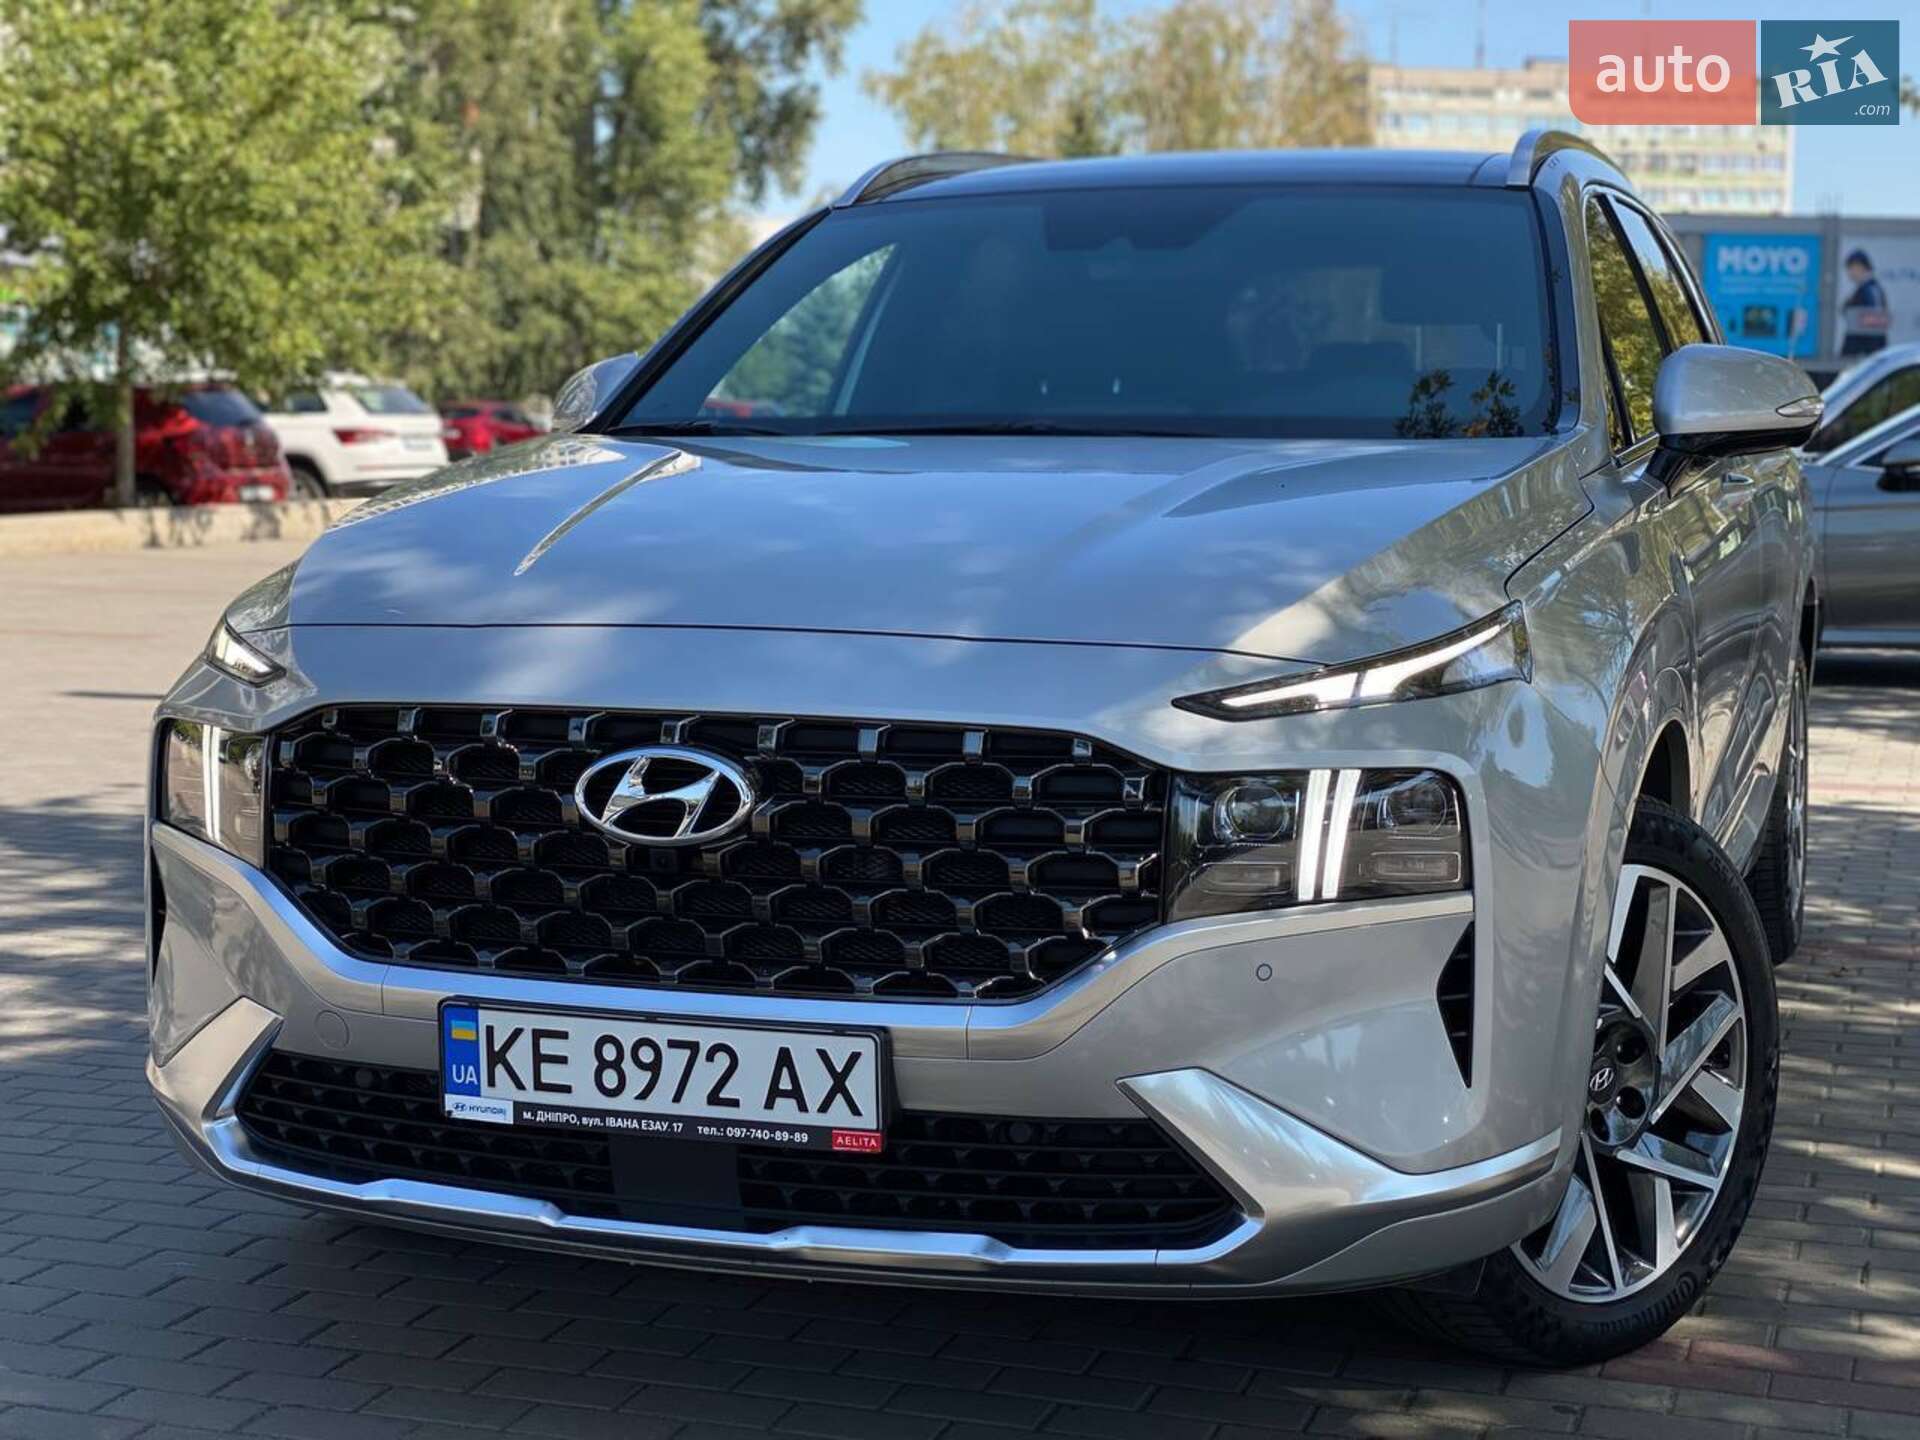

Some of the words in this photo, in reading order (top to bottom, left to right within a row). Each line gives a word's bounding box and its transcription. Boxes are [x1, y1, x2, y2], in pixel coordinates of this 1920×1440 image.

[1717, 246, 1809, 274] MOYO
[452, 1064, 478, 1085] UA
[484, 1024, 573, 1095] KE
[594, 1034, 740, 1108] 8972
[763, 1046, 864, 1117] AX
[606, 1117, 639, 1129] ІВАНА
[672, 1122, 683, 1133] 17
[726, 1126, 809, 1143] 097-740-89-89
[837, 1135, 877, 1148] AELITA
